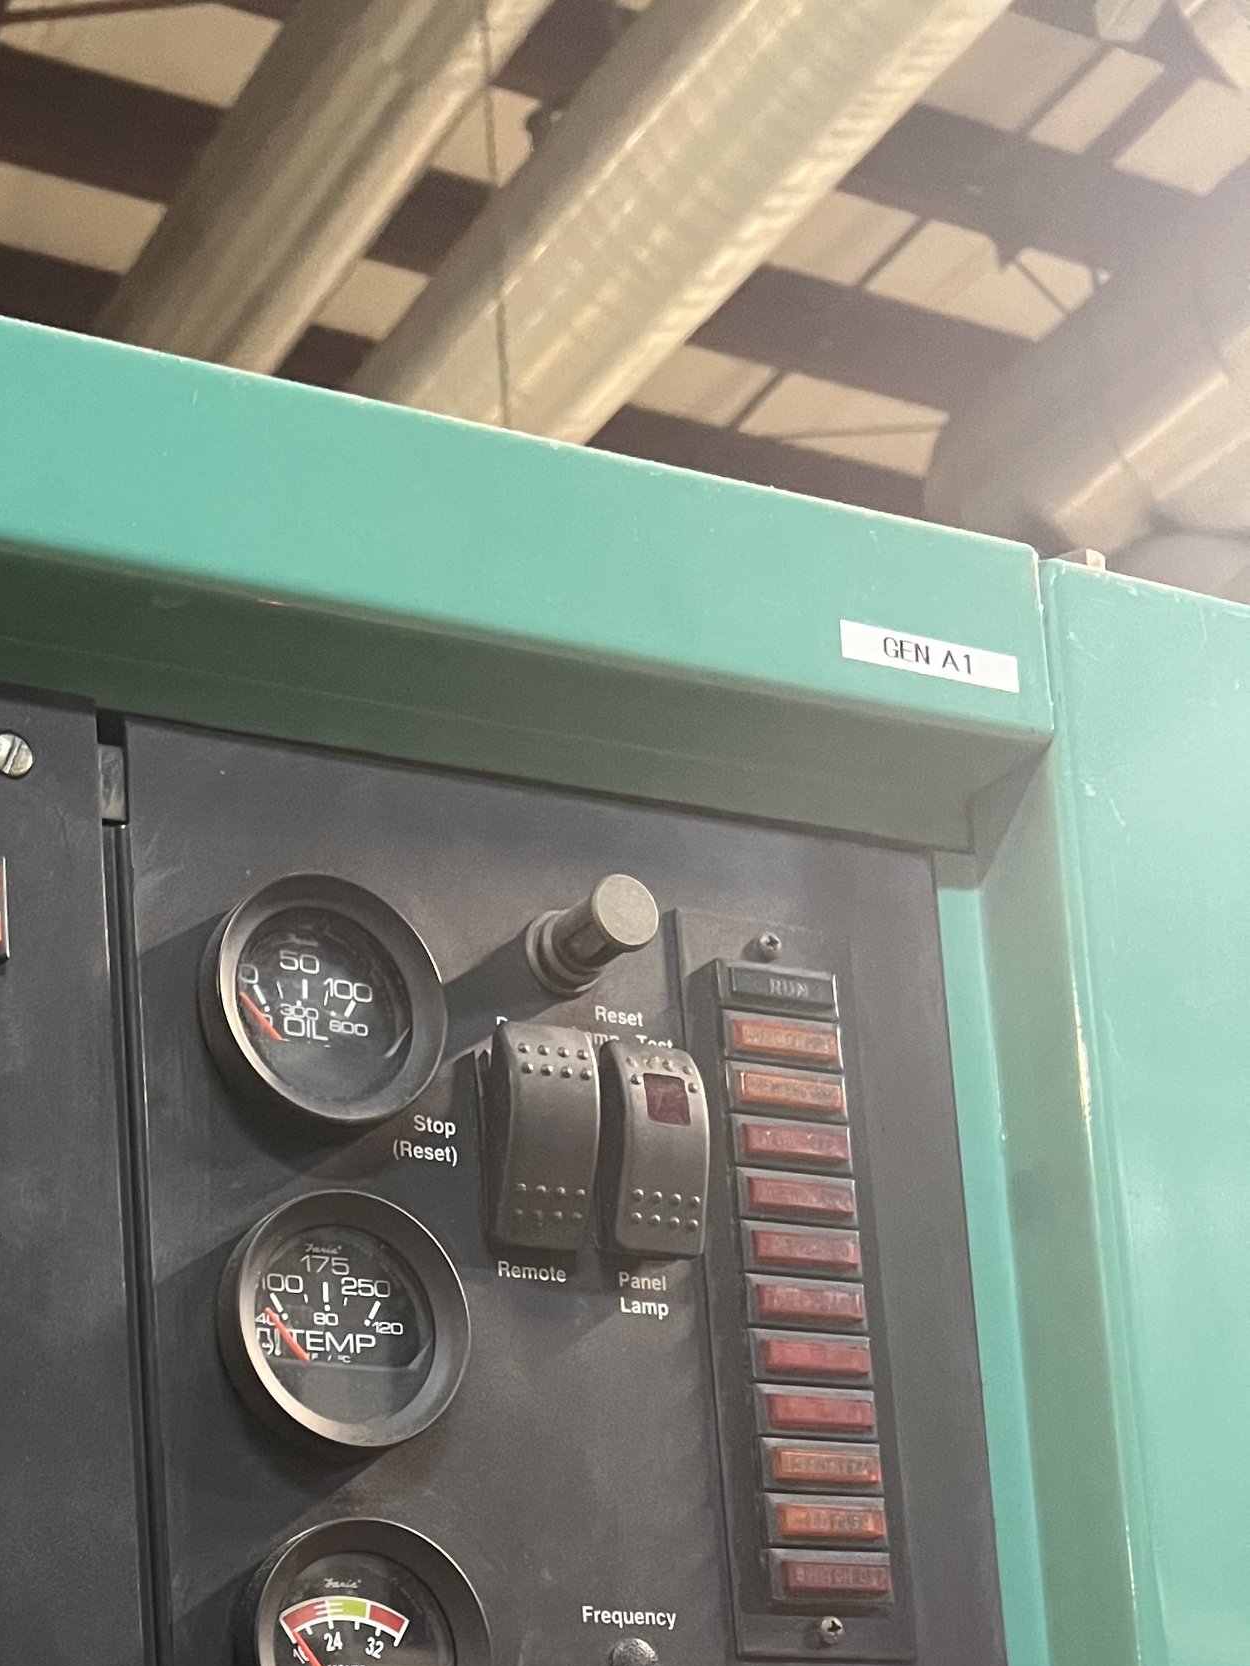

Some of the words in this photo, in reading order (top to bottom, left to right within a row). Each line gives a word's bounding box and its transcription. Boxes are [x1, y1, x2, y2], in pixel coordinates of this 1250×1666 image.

[883, 636, 931, 665] GEN
[942, 649, 972, 675] A1
[239, 963, 259, 985] 0
[279, 950, 320, 975] 50
[323, 977, 373, 1003] 100
[279, 1003, 319, 1021] 300
[329, 1019, 369, 1037] 600
[283, 1016, 329, 1041] OIL
[595, 1005, 643, 1027] Reset
[413, 1114, 457, 1136] Stop
[393, 1140, 458, 1167] (Reset)
[300, 1254, 350, 1276] 175
[341, 1276, 390, 1298] 250
[498, 1261, 567, 1283] Remote
[619, 1272, 667, 1291] Panel
[619, 1297, 669, 1320] Lamp
[313, 1312, 339, 1326] 80
[372, 1321, 404, 1335] 120
[289, 1329, 376, 1354] TEMP
[582, 1605, 677, 1631] Frequency
[323, 1631, 343, 1652] 24
[364, 1636, 384, 1659] 32
